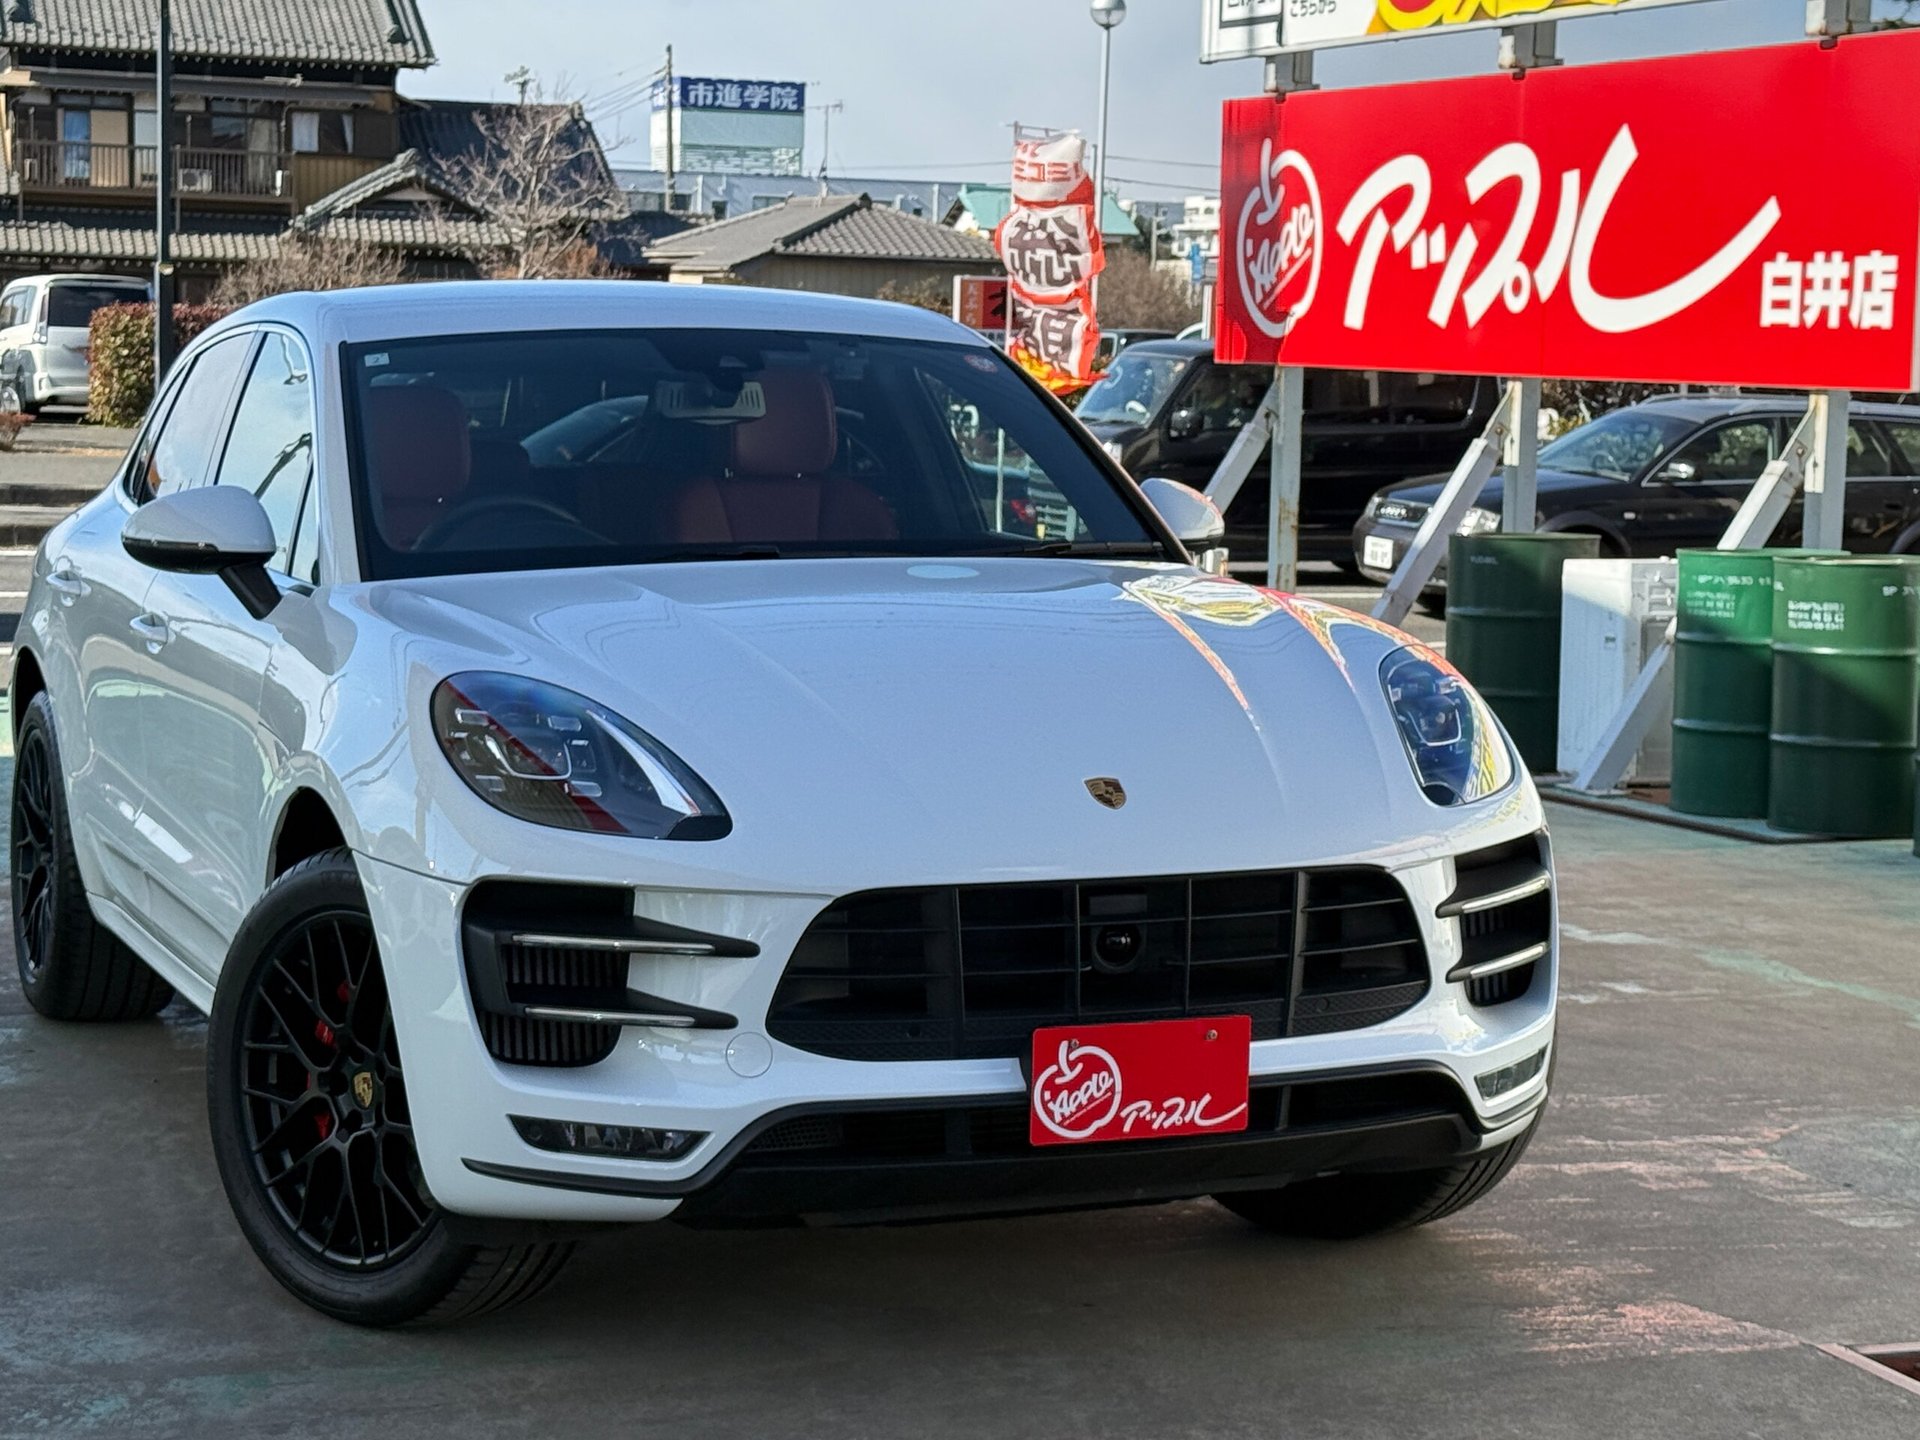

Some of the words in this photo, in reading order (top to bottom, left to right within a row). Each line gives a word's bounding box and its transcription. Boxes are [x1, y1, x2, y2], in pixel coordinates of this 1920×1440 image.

[687, 82, 798, 110] 市進学院
[1337, 124, 1781, 333] アップル
[1759, 251, 1899, 330] 白井店
[1046, 1070, 1114, 1124] Apple
[1120, 1093, 1248, 1133] アップル
